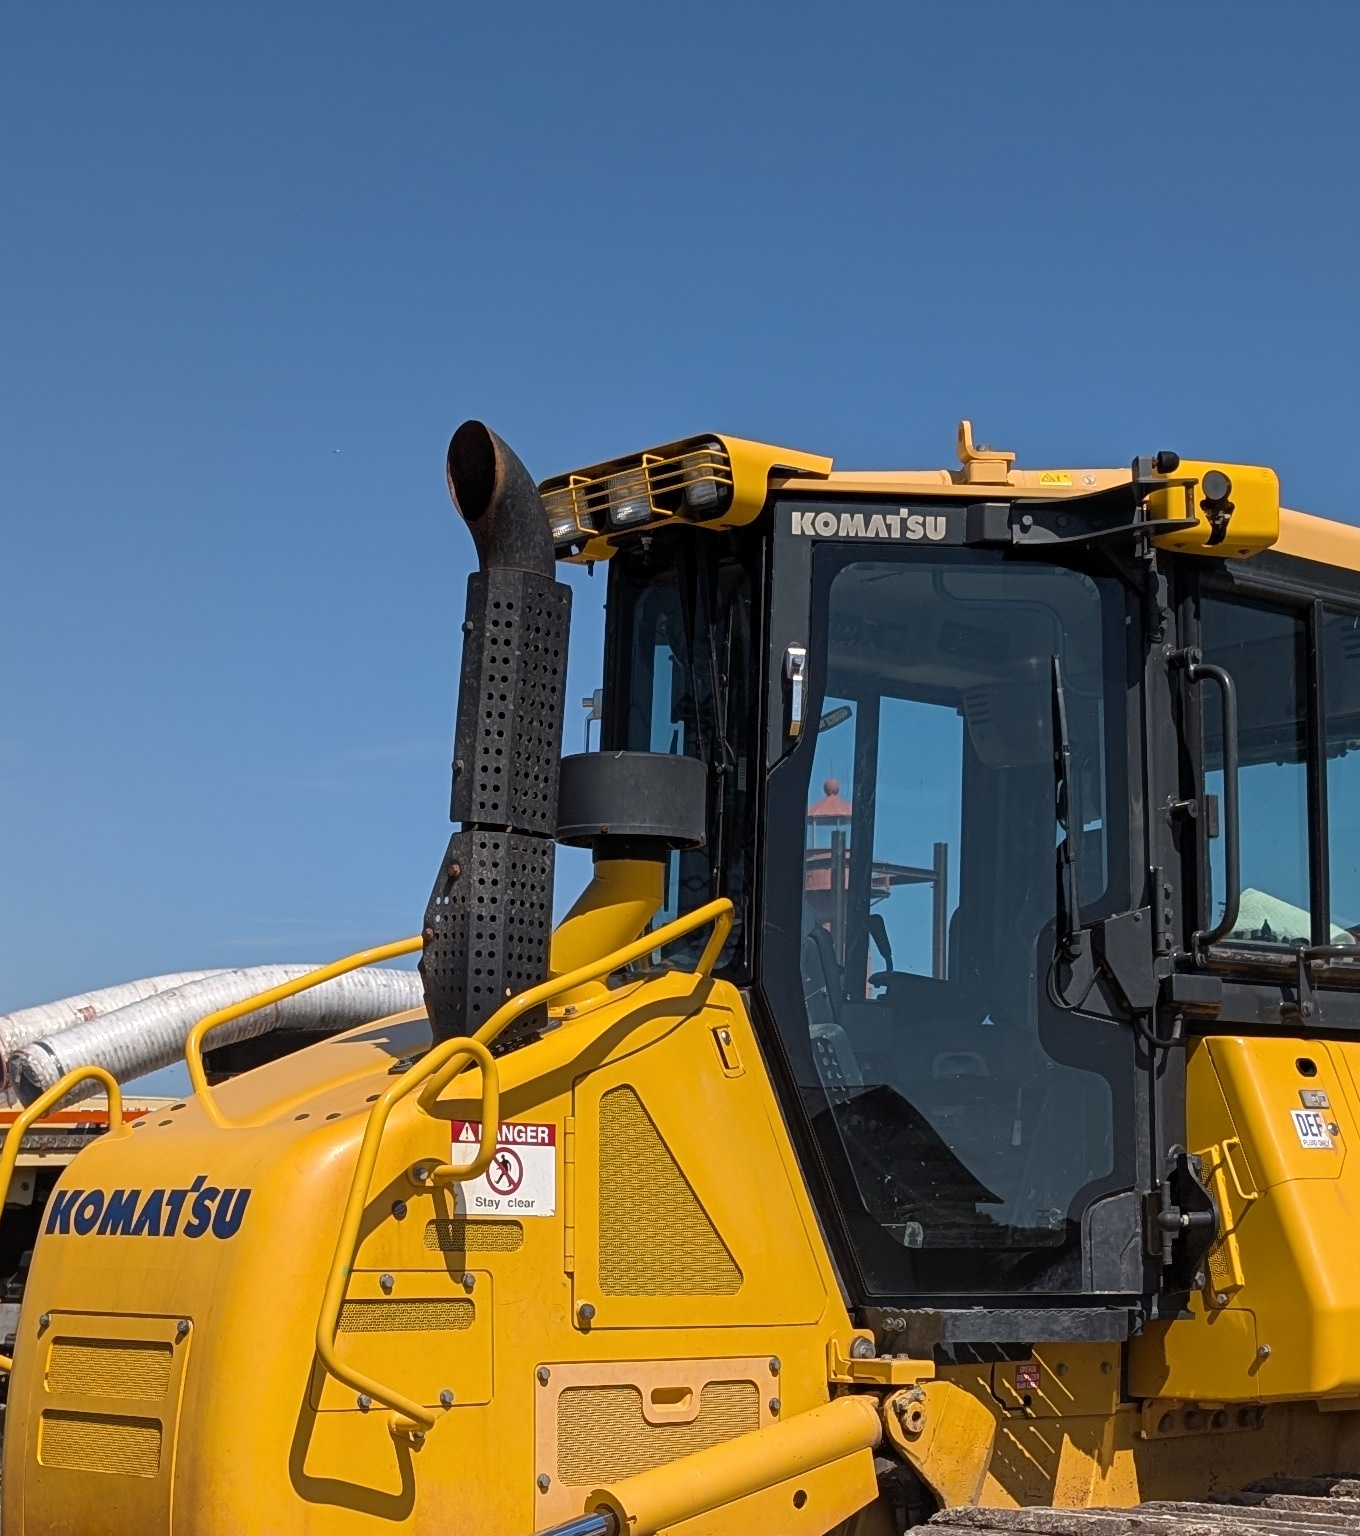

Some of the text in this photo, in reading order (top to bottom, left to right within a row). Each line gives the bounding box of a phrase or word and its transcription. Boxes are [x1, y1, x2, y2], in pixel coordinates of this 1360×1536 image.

[791, 507, 947, 541] KOMATSU
[478, 1123, 550, 1144] NGER
[1295, 1113, 1323, 1138] DEF
[44, 1175, 252, 1240] KOMATSU
[475, 1196, 536, 1210] Stay clear
